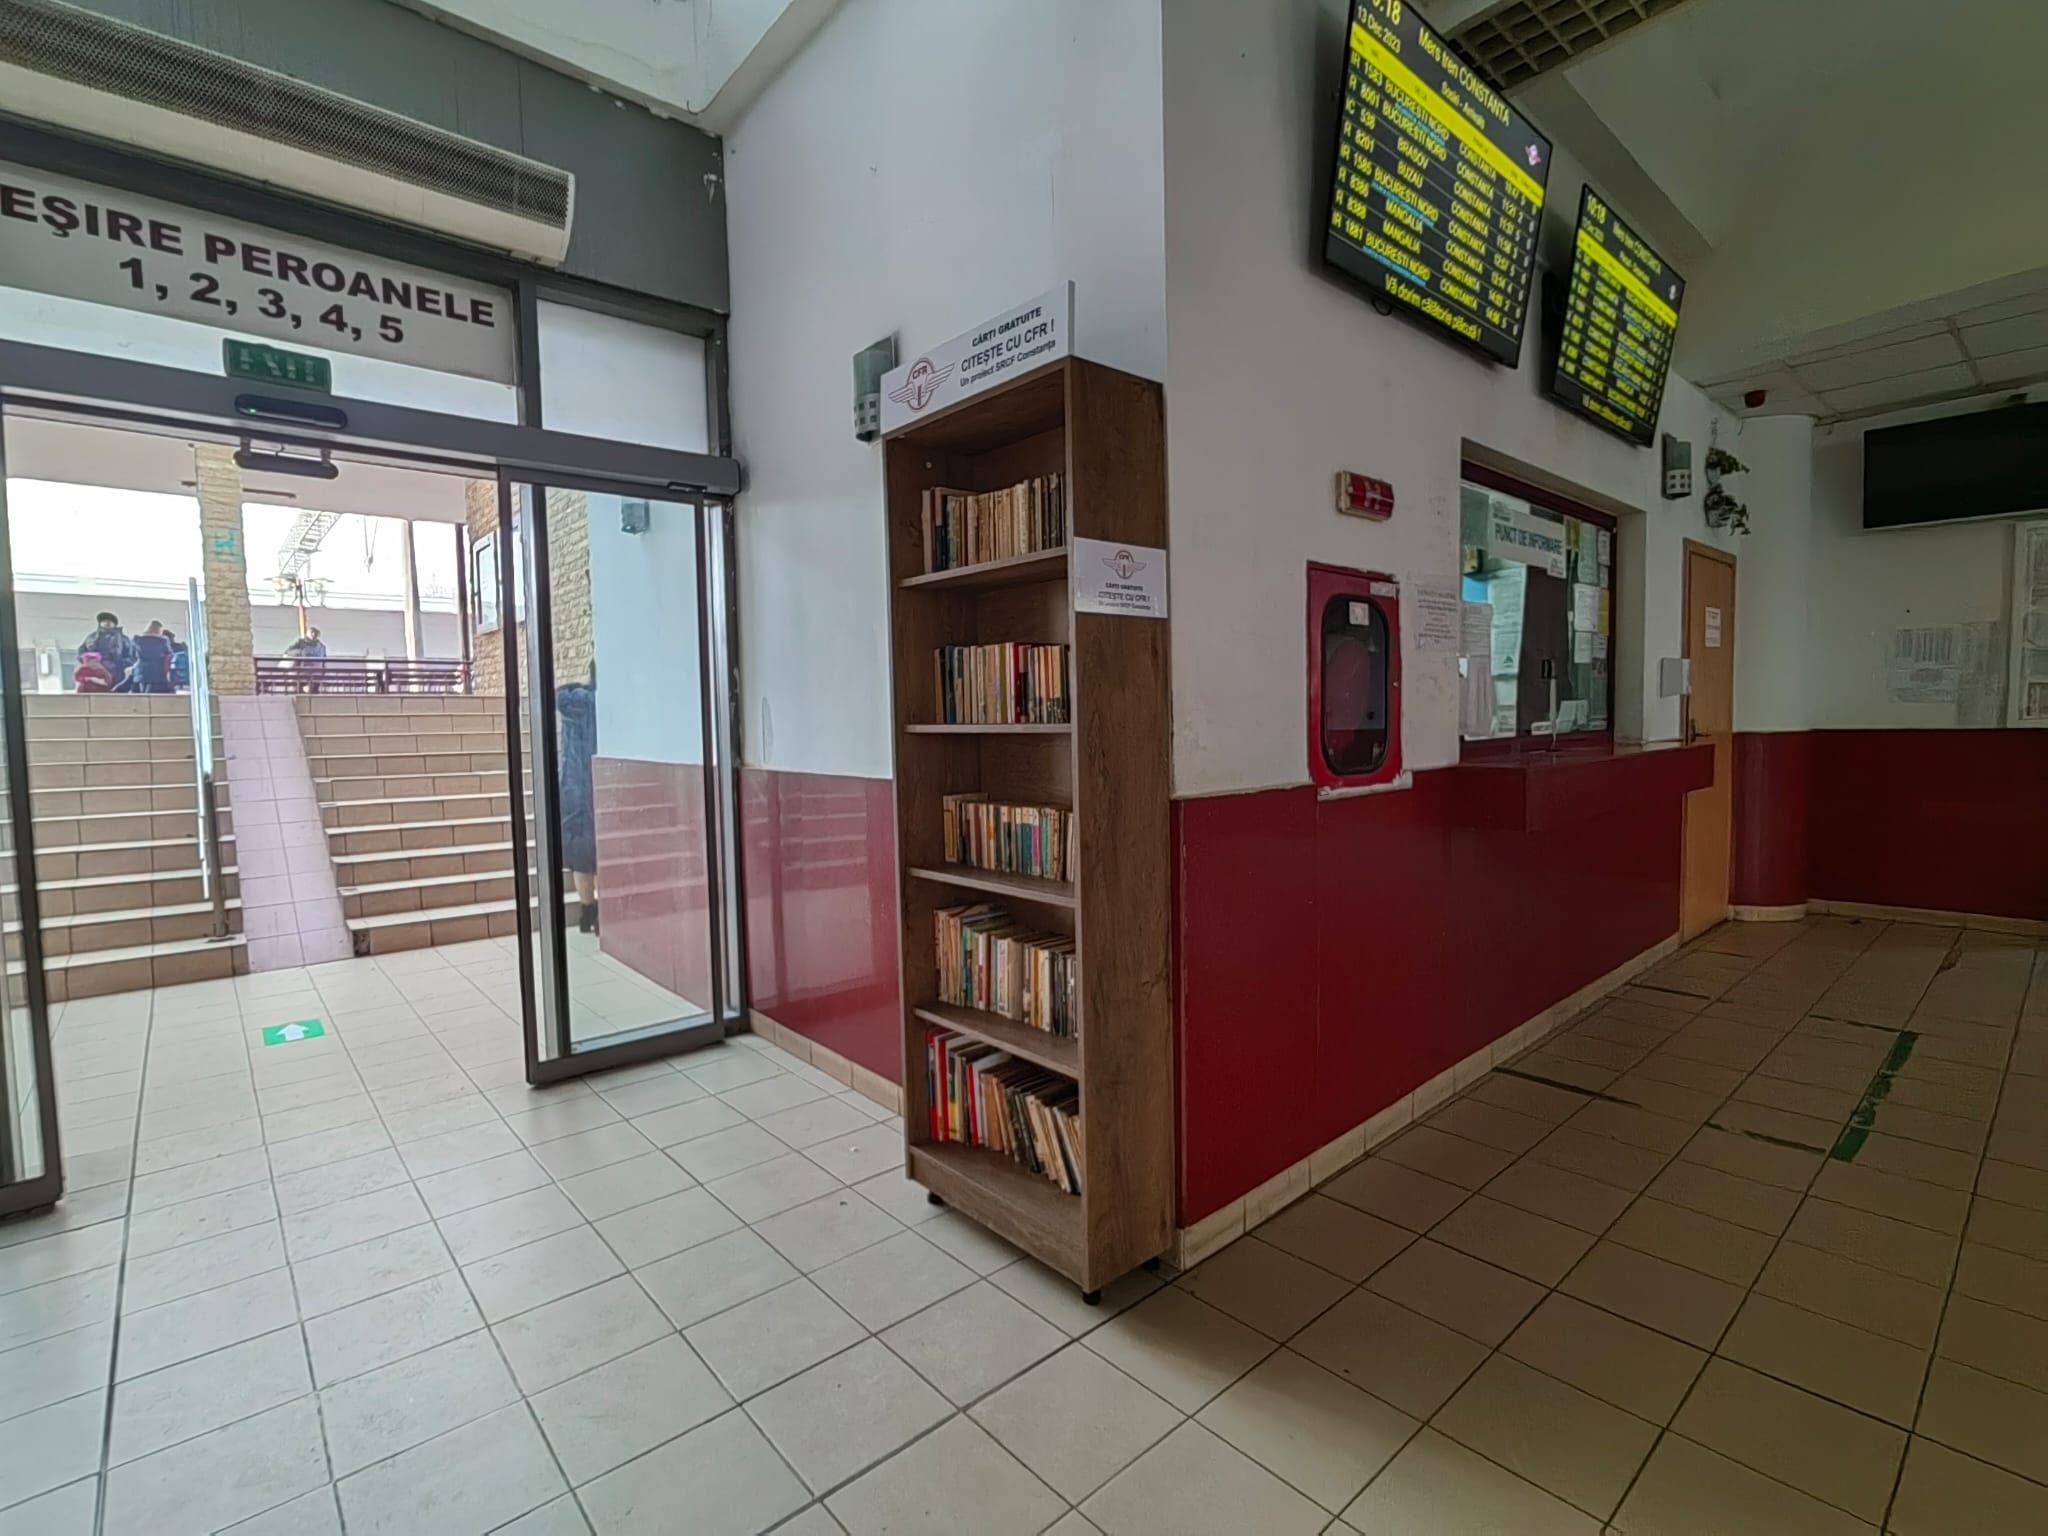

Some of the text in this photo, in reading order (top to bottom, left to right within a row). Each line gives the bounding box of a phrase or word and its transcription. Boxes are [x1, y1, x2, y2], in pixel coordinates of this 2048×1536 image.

[1350, 51, 1360, 70] IR
[1349, 73, 1356, 91] R
[1419, 28, 1441, 62] Mers
[1442, 52, 1458, 78] tren
[1459, 64, 1510, 127] CONSTANTA
[1345, 96, 1355, 115] IC
[1343, 119, 1351, 137] R
[1340, 141, 1350, 160] IR
[1338, 165, 1346, 182] R
[1336, 188, 1343, 205] R
[1332, 210, 1342, 228] IR
[204, 232, 496, 329] PEROANELE
[119, 257, 405, 344] 1, 2, 3, 4, 5
[998, 306, 1042, 335] GRATUITE
[1006, 333, 1021, 352] CU
[1024, 322, 1047, 343] CFR
[912, 364, 930, 381] CFR
